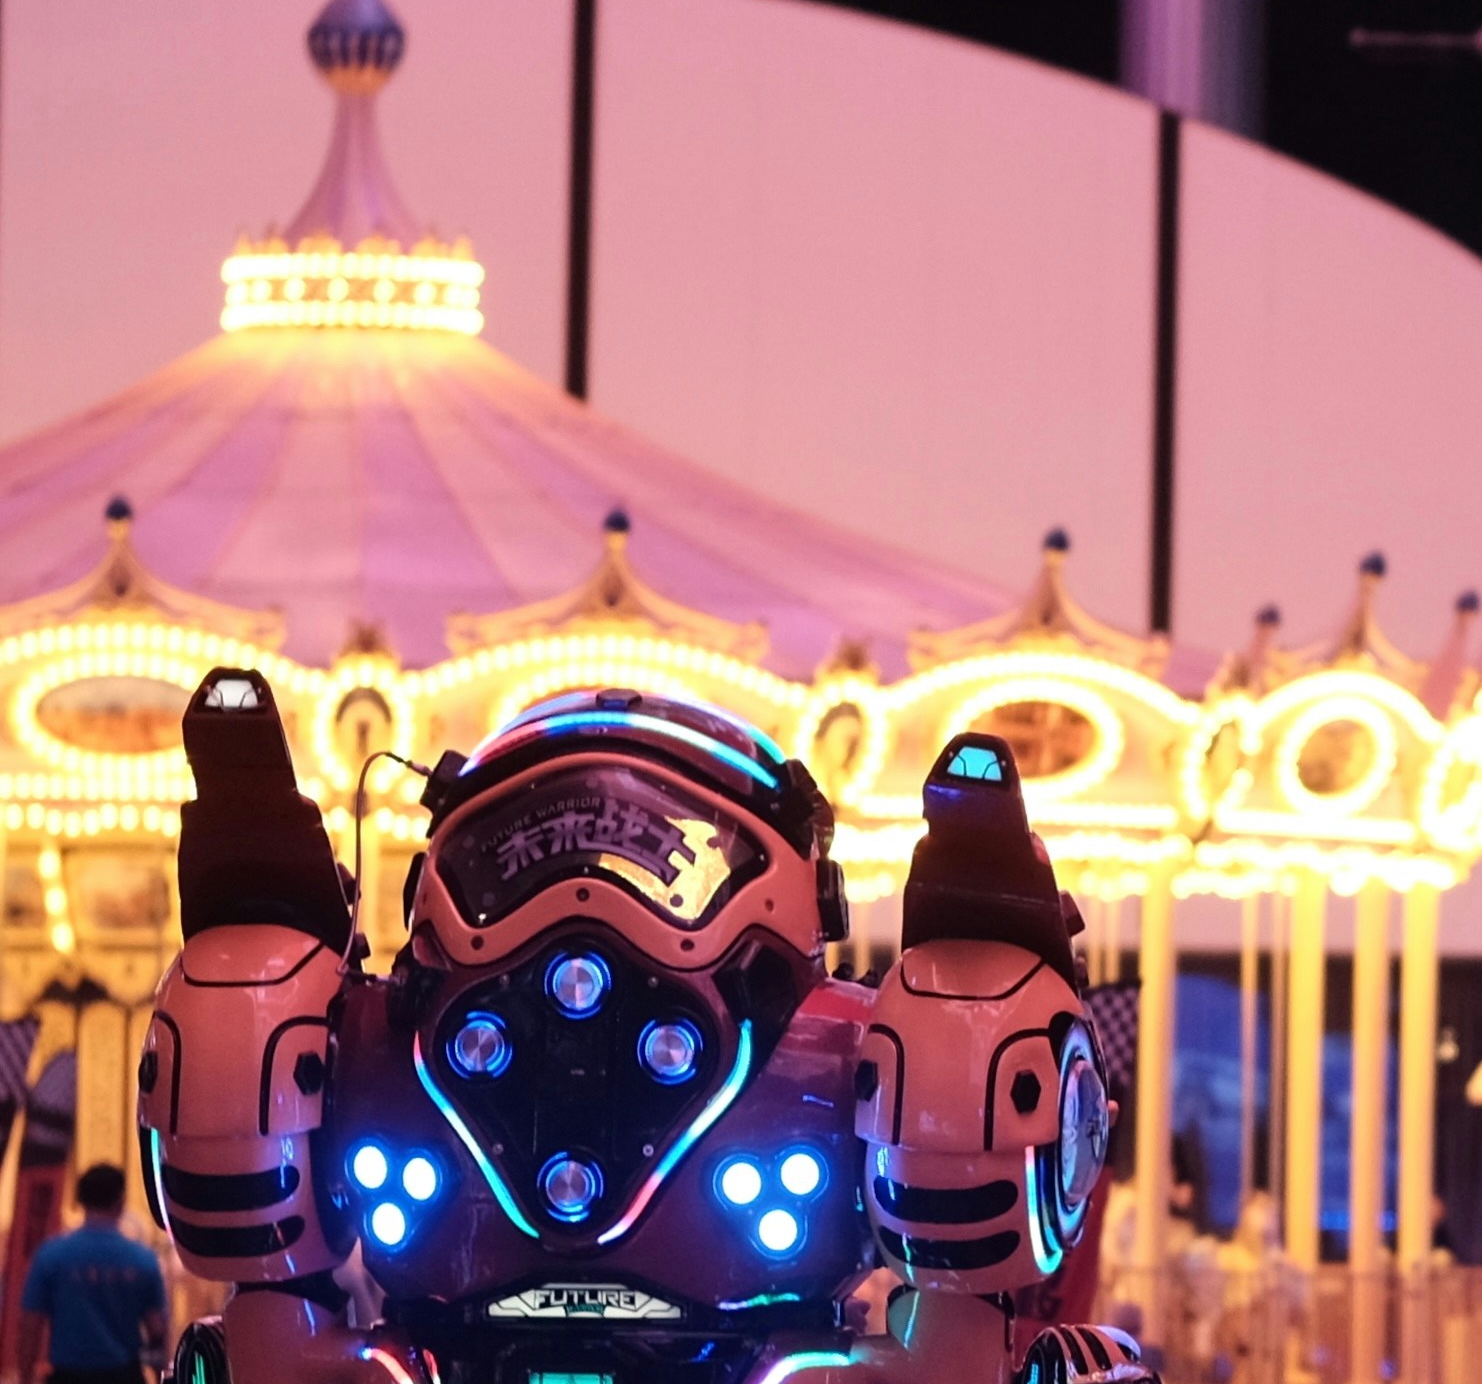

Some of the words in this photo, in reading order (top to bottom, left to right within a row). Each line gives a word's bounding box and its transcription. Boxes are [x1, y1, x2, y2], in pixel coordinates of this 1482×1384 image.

[535, 797, 602, 818] WARRIOR
[497, 797, 696, 887] 未来战士
[535, 1289, 637, 1311] FUTURE
